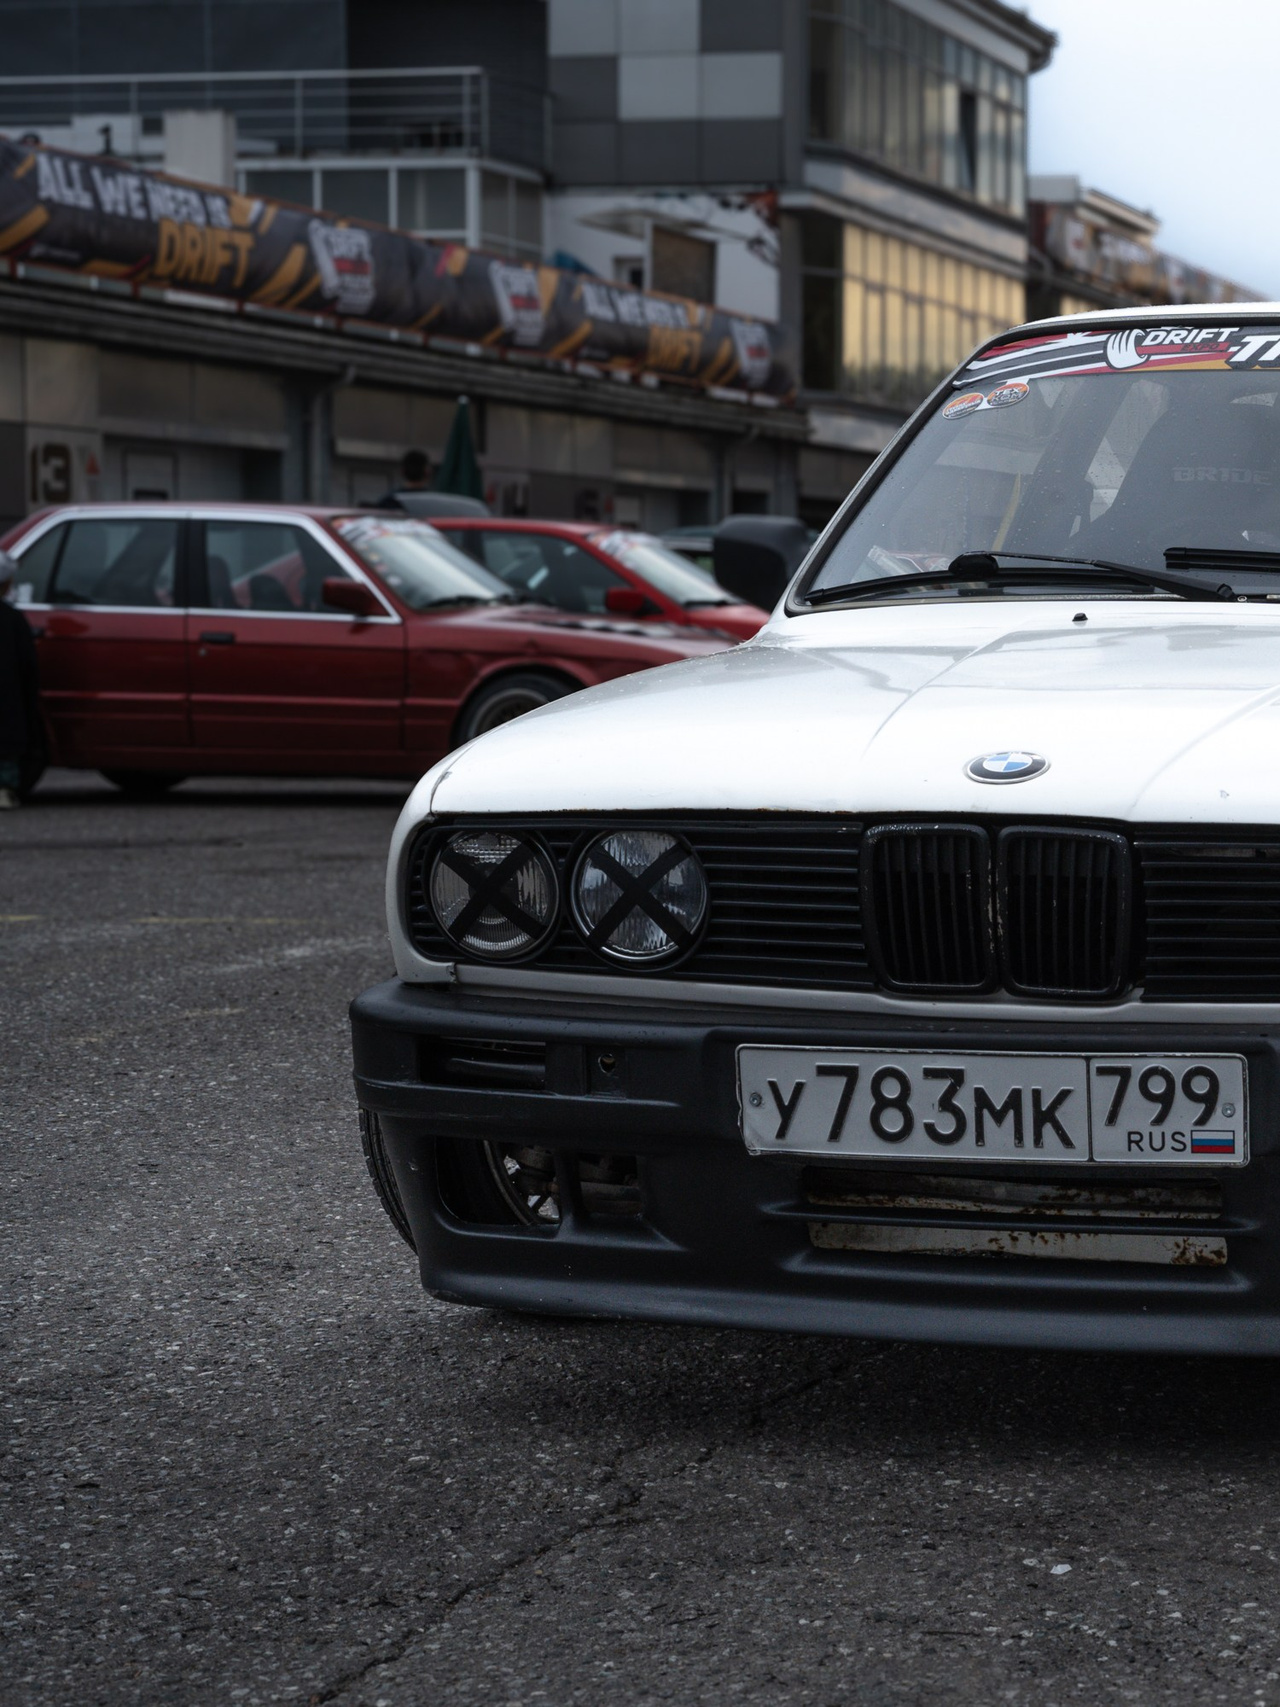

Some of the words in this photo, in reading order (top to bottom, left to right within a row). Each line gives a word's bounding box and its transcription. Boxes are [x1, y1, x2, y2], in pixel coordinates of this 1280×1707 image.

[35, 151, 95, 211] ALL
[89, 165, 149, 221] WE
[154, 217, 256, 289] DRIFT
[1141, 327, 1240, 346] DRIFT
[1180, 343, 1220, 352] EXPO
[1171, 466, 1273, 486] BRIDE
[1095, 1065, 1221, 1127] 799
[1127, 1130, 1188, 1153] RUS
